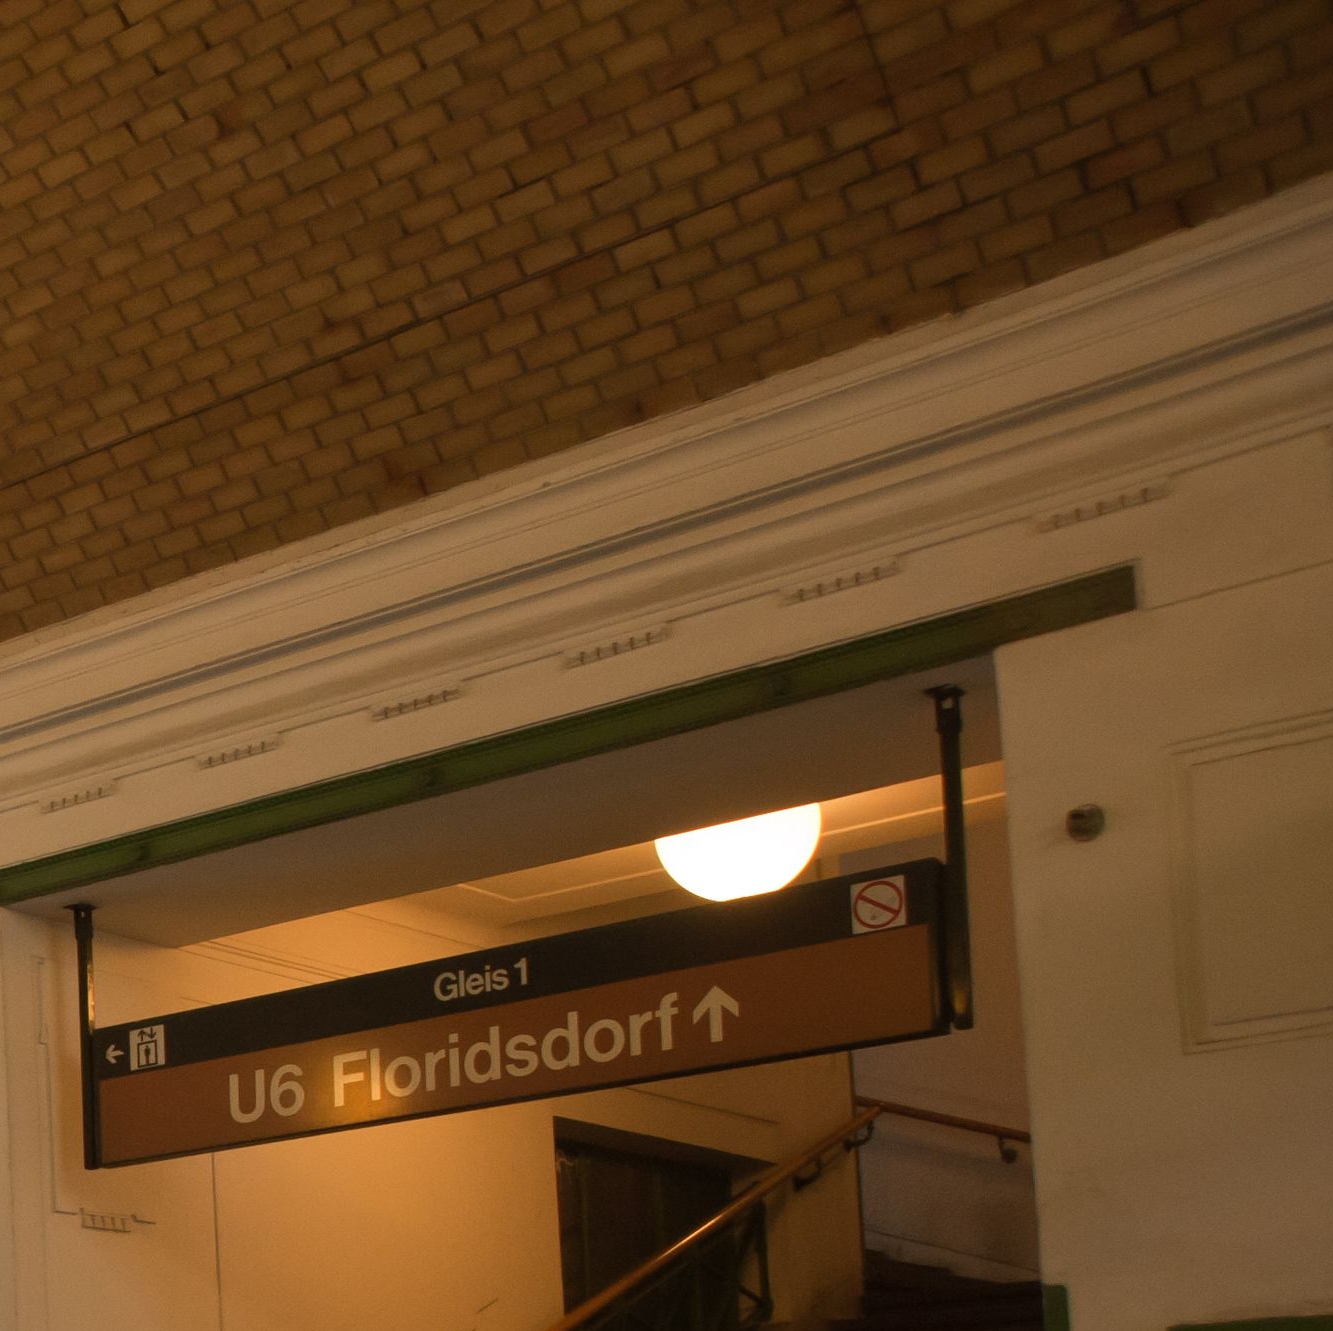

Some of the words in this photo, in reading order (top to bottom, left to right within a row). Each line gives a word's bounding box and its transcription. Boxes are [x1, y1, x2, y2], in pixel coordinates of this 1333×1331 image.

[434, 965, 510, 1002] Gleis
[513, 957, 529, 986] 1
[229, 1065, 305, 1124] U6
[333, 992, 679, 1108] Floridsdorf
